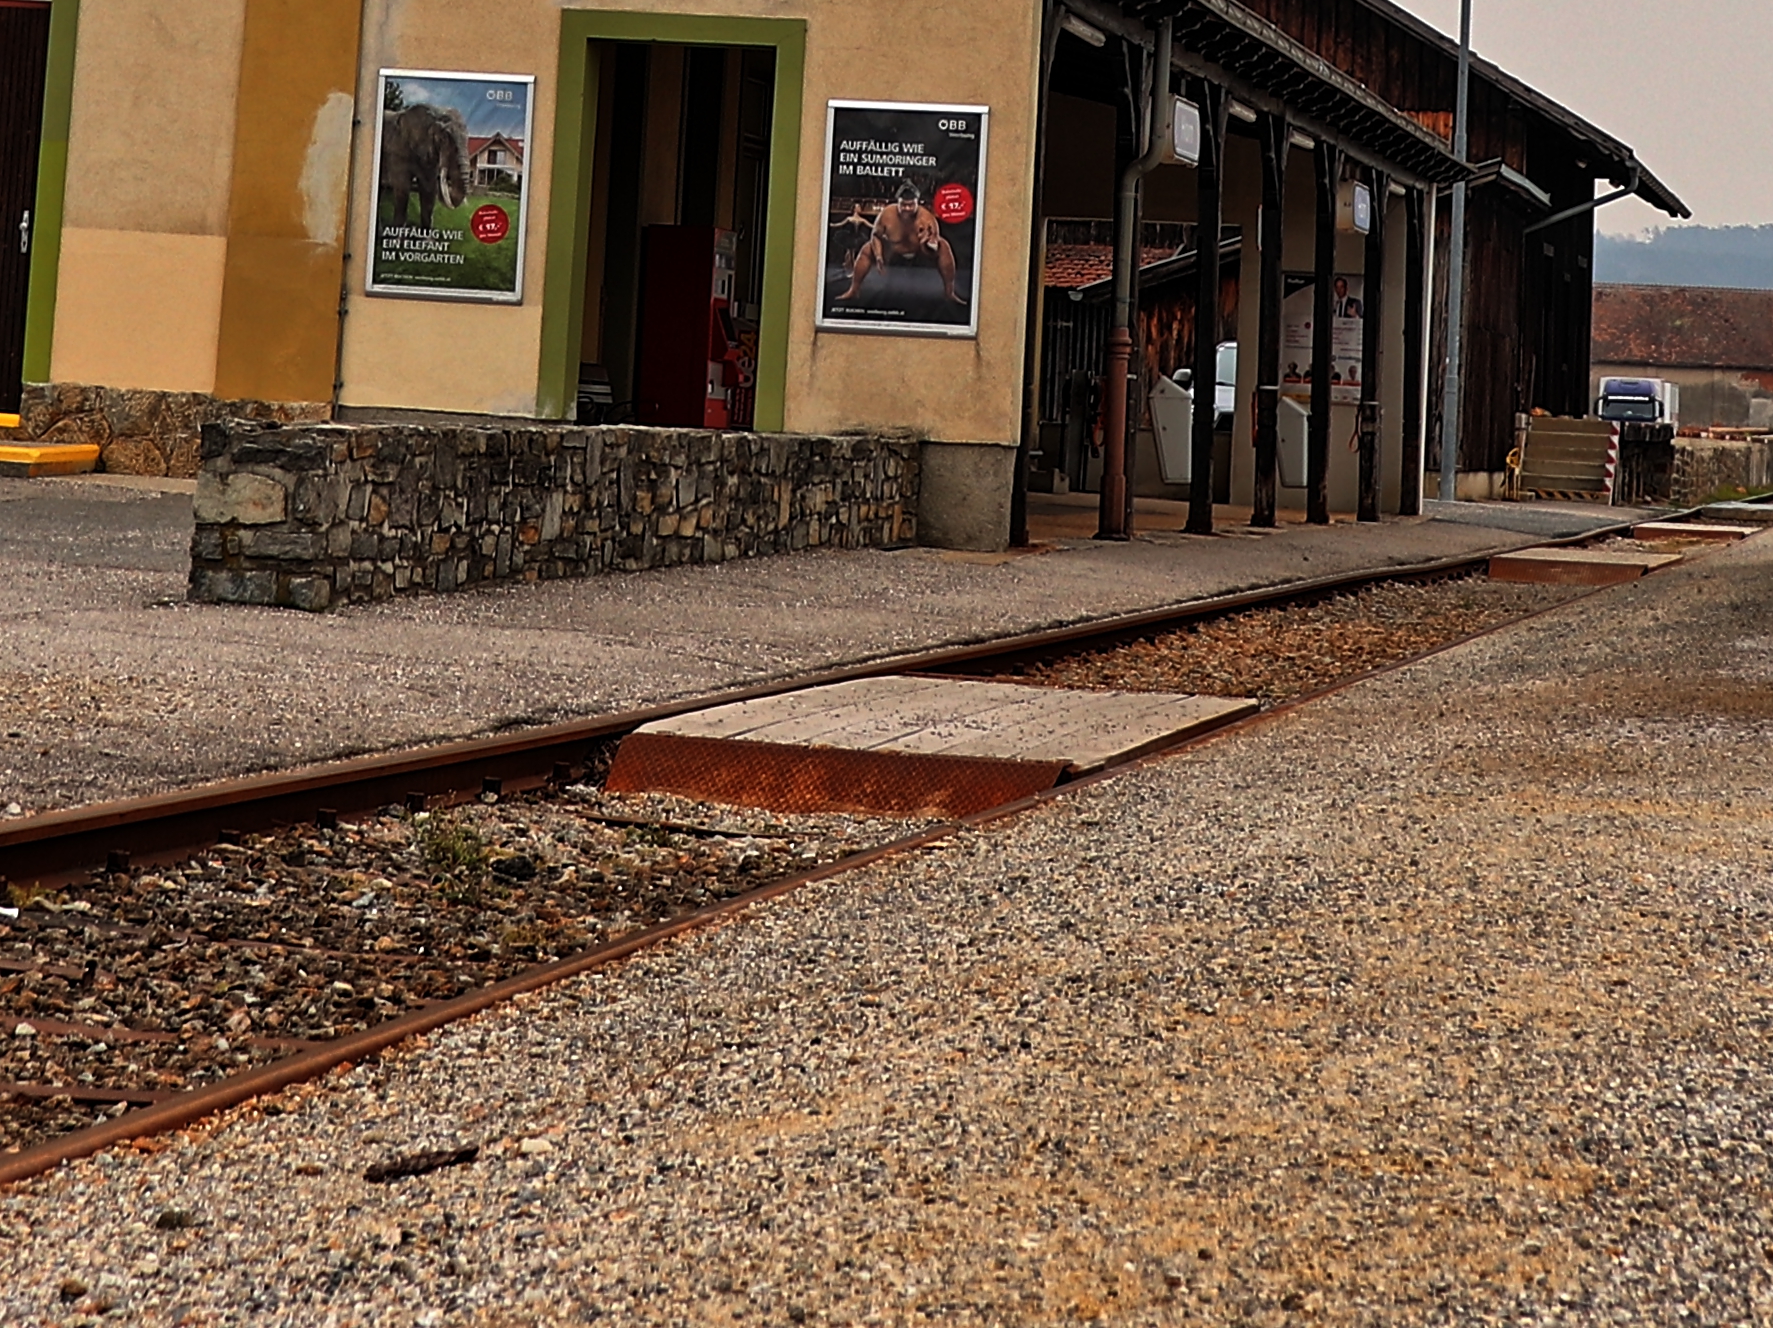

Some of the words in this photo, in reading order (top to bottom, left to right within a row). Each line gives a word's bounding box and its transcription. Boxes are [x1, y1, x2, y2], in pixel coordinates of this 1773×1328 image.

[840, 139, 900, 153] AUFFÄLLIG
[902, 142, 925, 154] WIE
[839, 152, 859, 163] EIN
[861, 153, 937, 167] SUMORINGER
[838, 164, 854, 175] IM
[856, 165, 905, 177] BALLETT
[382, 225, 440, 239] AUFFÄLLIG
[442, 229, 464, 241] WIE
[382, 238, 401, 249] EIN
[403, 239, 450, 252] ELEFANT
[381, 250, 396, 261] IM
[399, 251, 465, 265] VORGARTEN
